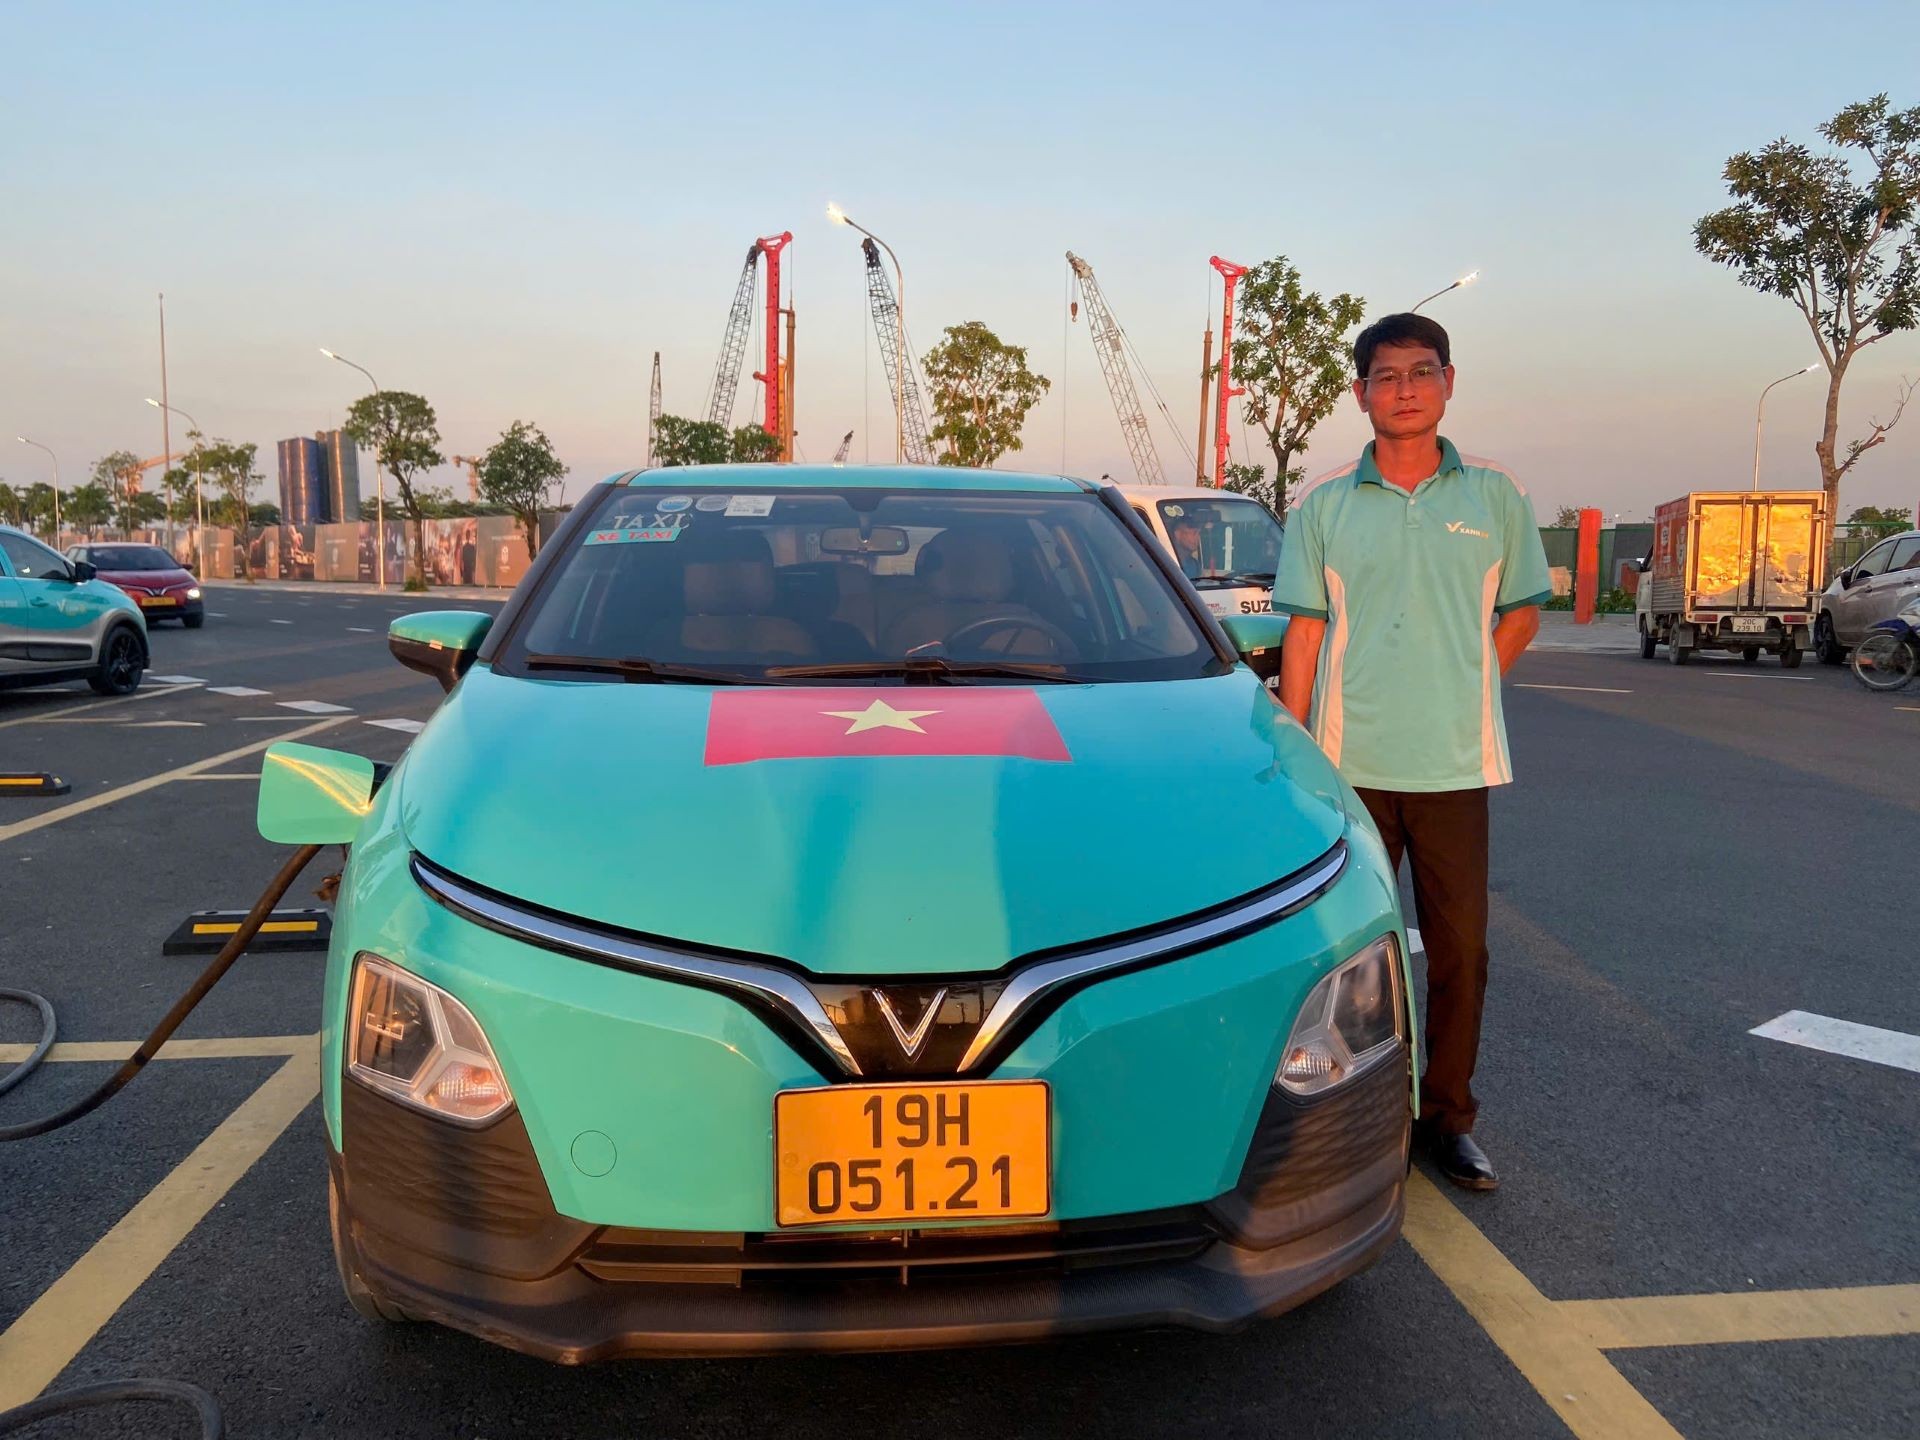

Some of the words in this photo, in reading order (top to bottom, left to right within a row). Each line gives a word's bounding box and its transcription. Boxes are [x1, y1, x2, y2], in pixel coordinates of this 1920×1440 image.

[596, 533, 619, 541] XE
[629, 531, 672, 540] TAXI
[1240, 600, 1272, 614] SUZ
[863, 1093, 970, 1148] 19H
[808, 1155, 1010, 1214] 051.21
